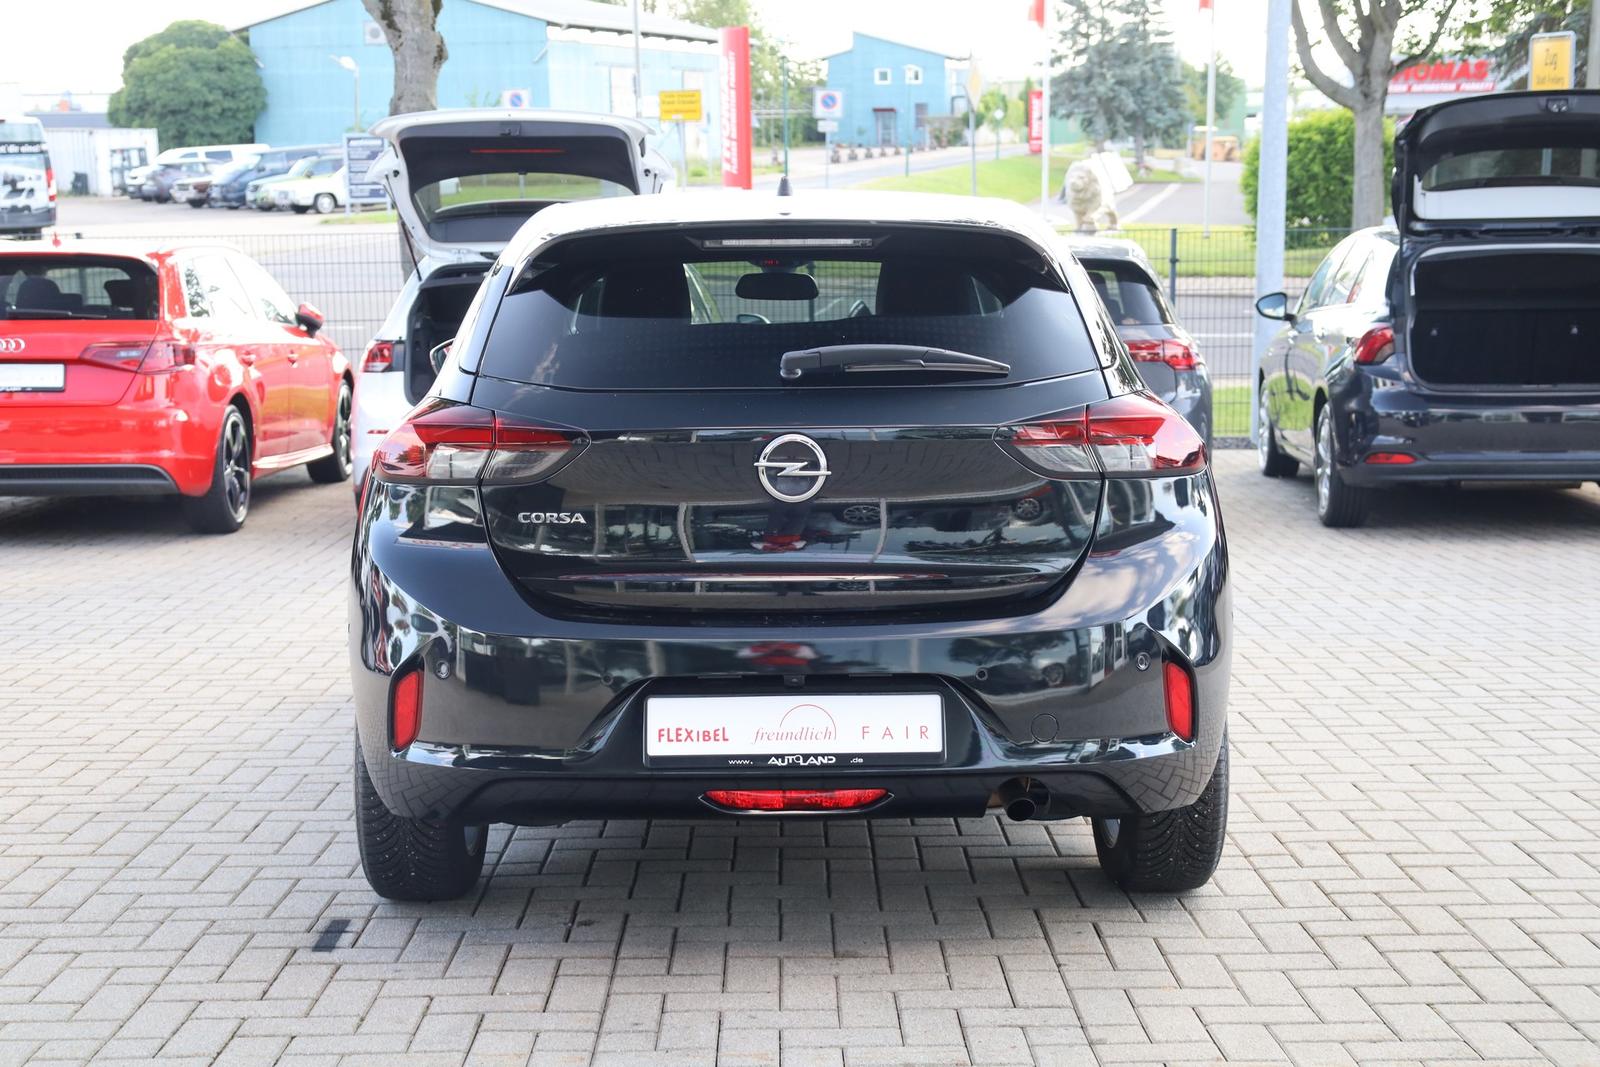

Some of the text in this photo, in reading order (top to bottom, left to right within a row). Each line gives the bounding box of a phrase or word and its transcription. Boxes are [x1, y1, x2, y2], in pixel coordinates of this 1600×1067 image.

[1391, 59, 1490, 81] HOMAS
[517, 512, 587, 524] CORSA
[657, 725, 929, 745] FLEXIBEL freundlich FAIR
[767, 754, 837, 767] AUTOLAND
